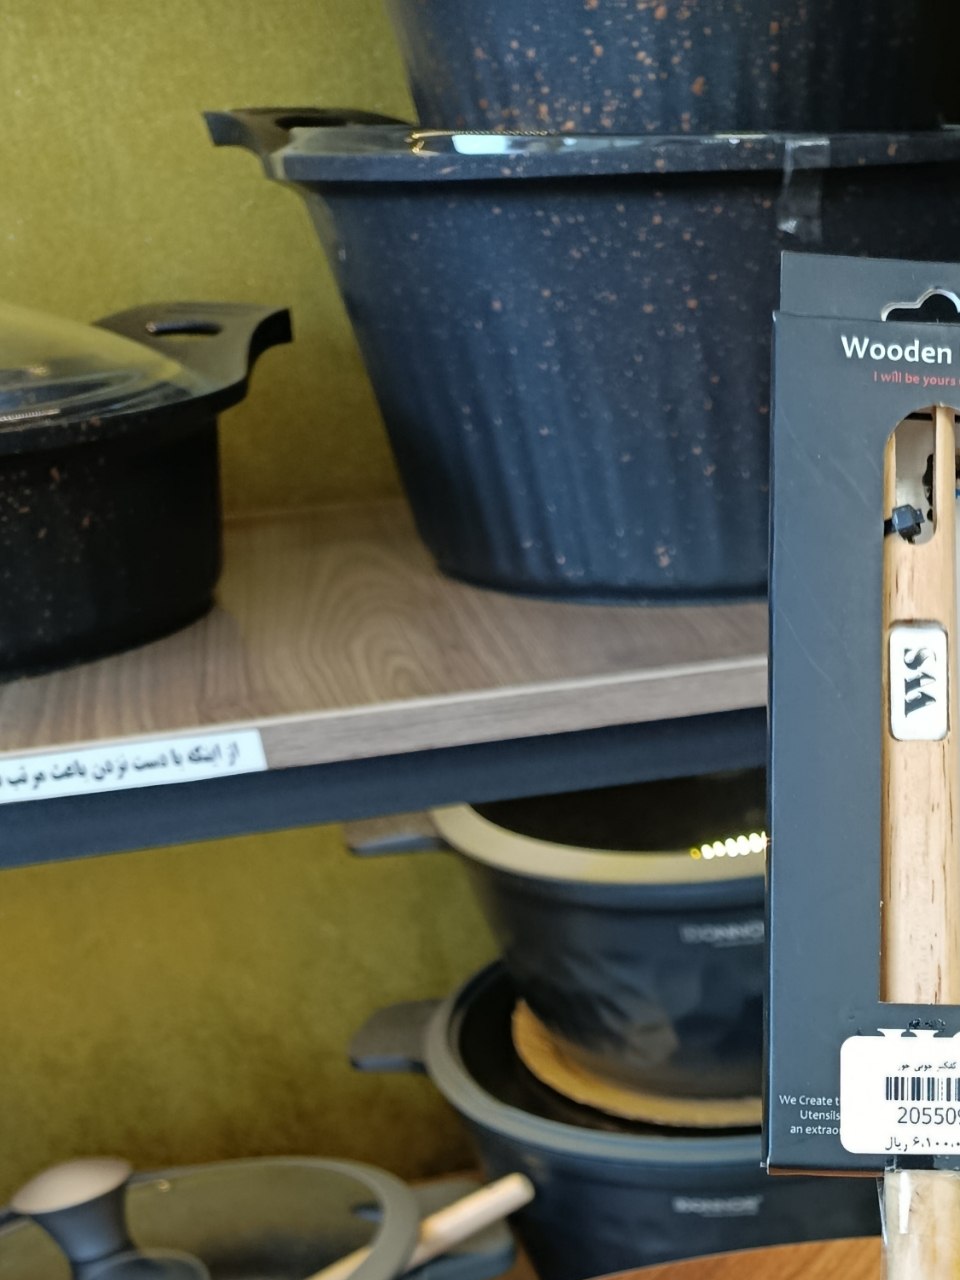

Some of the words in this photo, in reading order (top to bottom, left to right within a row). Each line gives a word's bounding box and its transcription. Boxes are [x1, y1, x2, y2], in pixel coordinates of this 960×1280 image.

[840, 335, 952, 364] Wooden
[873, 371, 878, 382] I
[881, 371, 902, 383] will
[905, 372, 920, 384] be
[923, 375, 956, 388] yours
[779, 1095, 797, 1105] We
[799, 1095, 833, 1106] Create
[800, 1110, 841, 1120] Utensils
[790, 1126, 803, 1134] an
[805, 1125, 840, 1135] extrao
[885, 1136, 908, 1152] ریال
